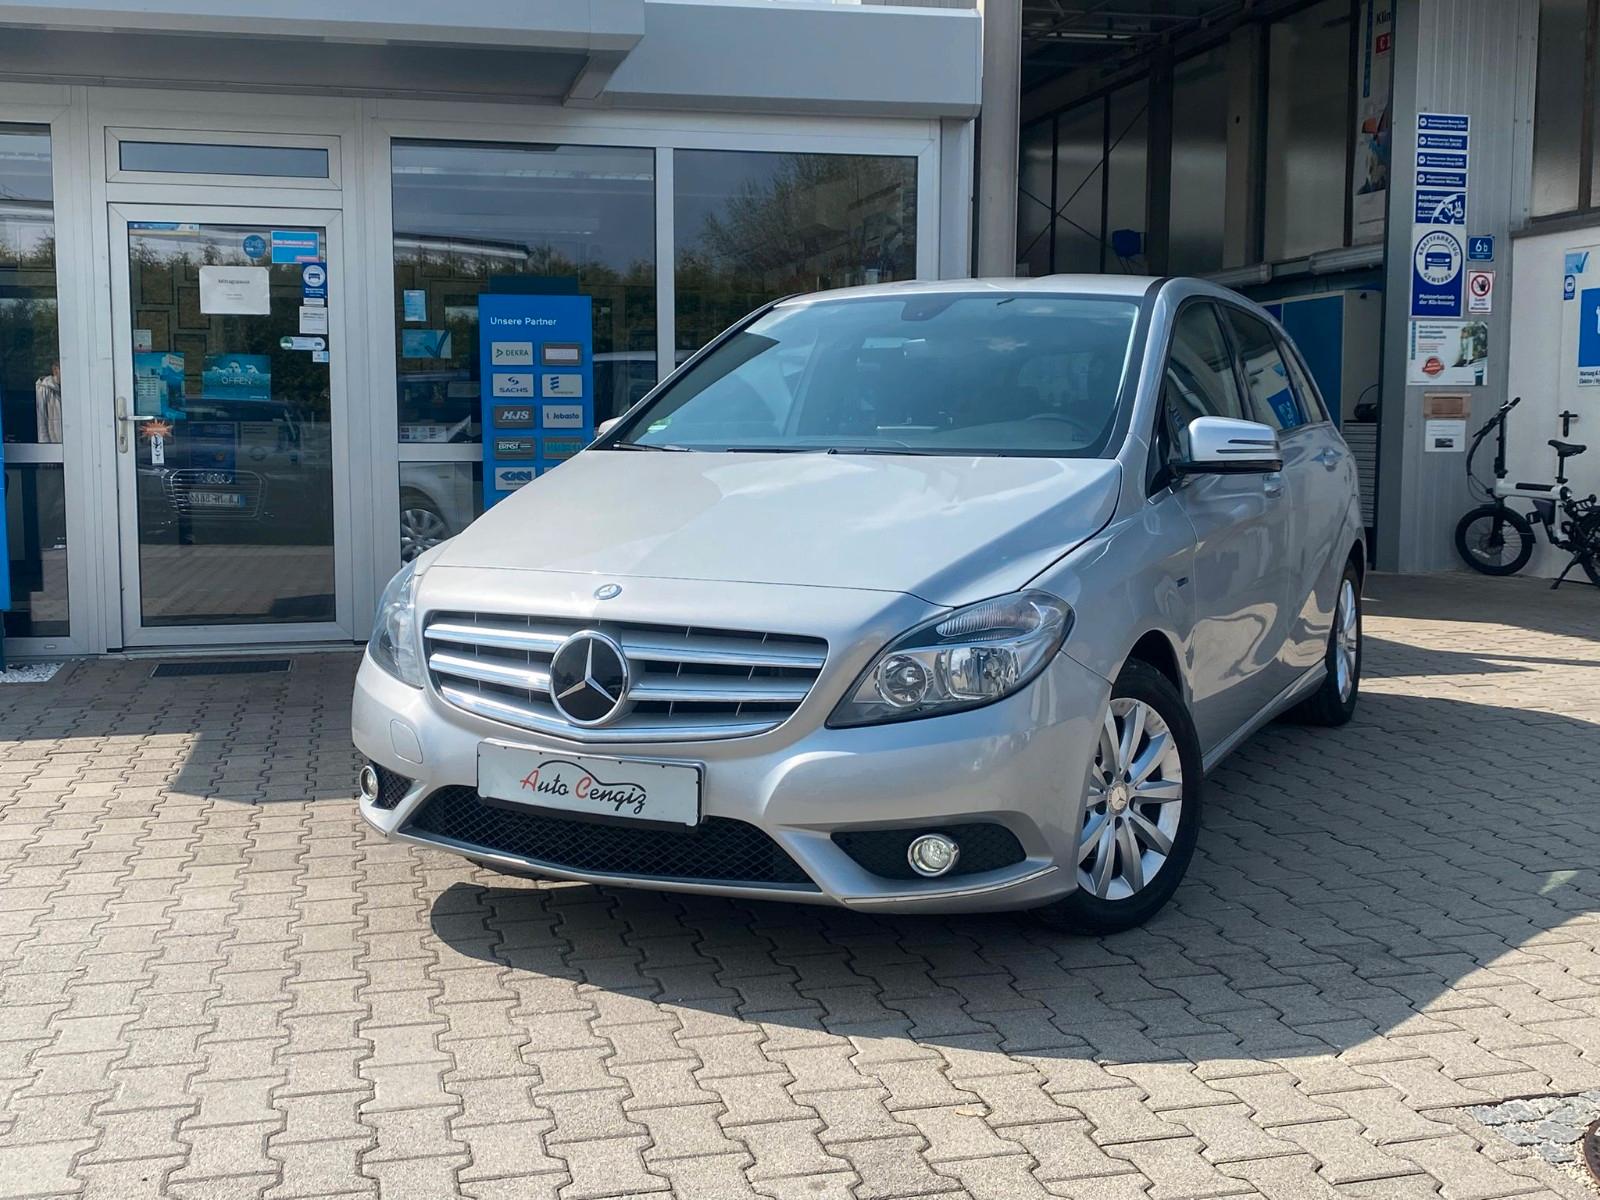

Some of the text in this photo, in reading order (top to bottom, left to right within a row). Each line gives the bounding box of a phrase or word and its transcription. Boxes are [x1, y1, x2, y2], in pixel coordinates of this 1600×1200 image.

[490, 316, 557, 326] Unsere Partner
[505, 349, 529, 357] DEKRA
[221, 376, 253, 385] OFFEN
[502, 410, 529, 420] HJS
[498, 442, 519, 450] ERNST
[520, 769, 647, 815] Auto Cengiz
